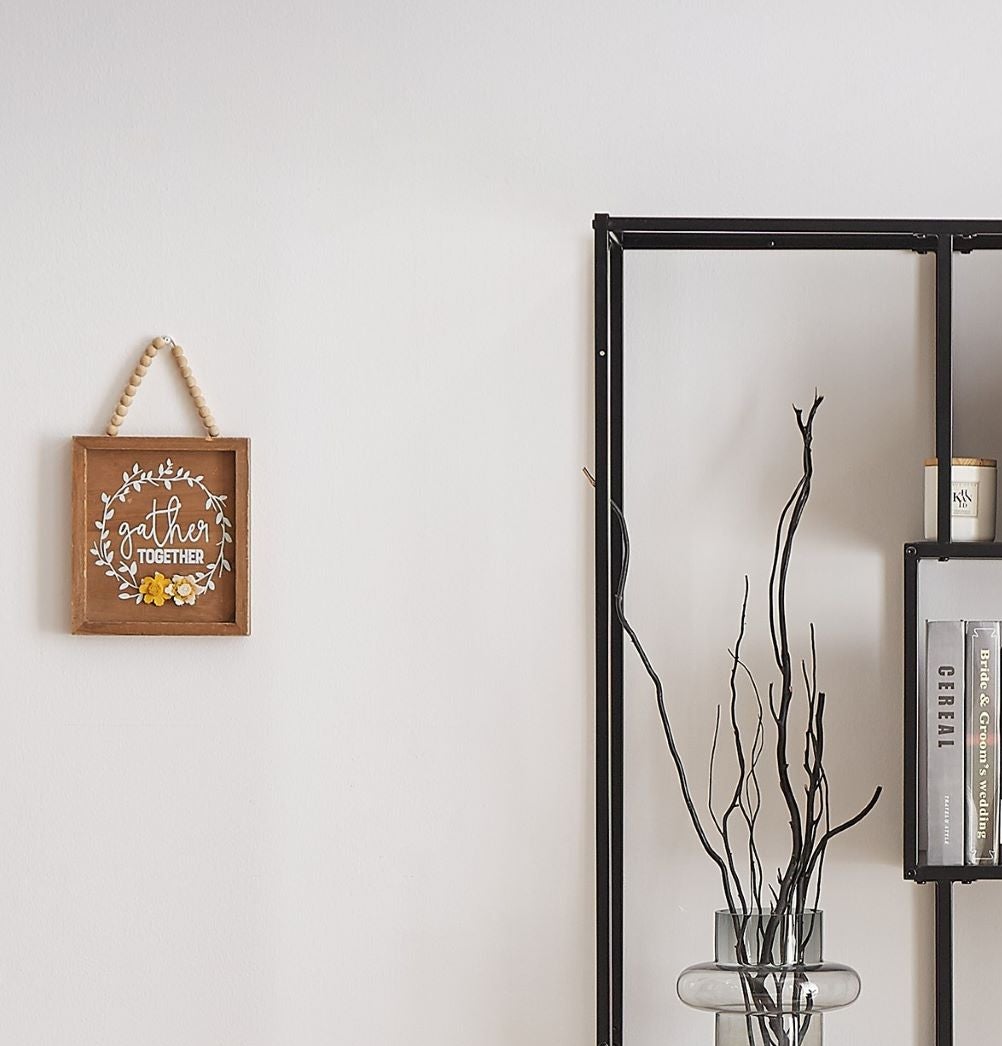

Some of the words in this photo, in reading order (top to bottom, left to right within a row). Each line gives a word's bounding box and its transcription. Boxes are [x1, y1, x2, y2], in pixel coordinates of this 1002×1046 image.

[118, 495, 210, 560] gather
[137, 548, 204, 564] TOGETHER
[978, 648, 991, 689] Bride
[937, 665, 955, 748] CEREAL
[978, 691, 991, 708] &
[977, 711, 991, 777] Groom's
[976, 779, 991, 840] wedding
